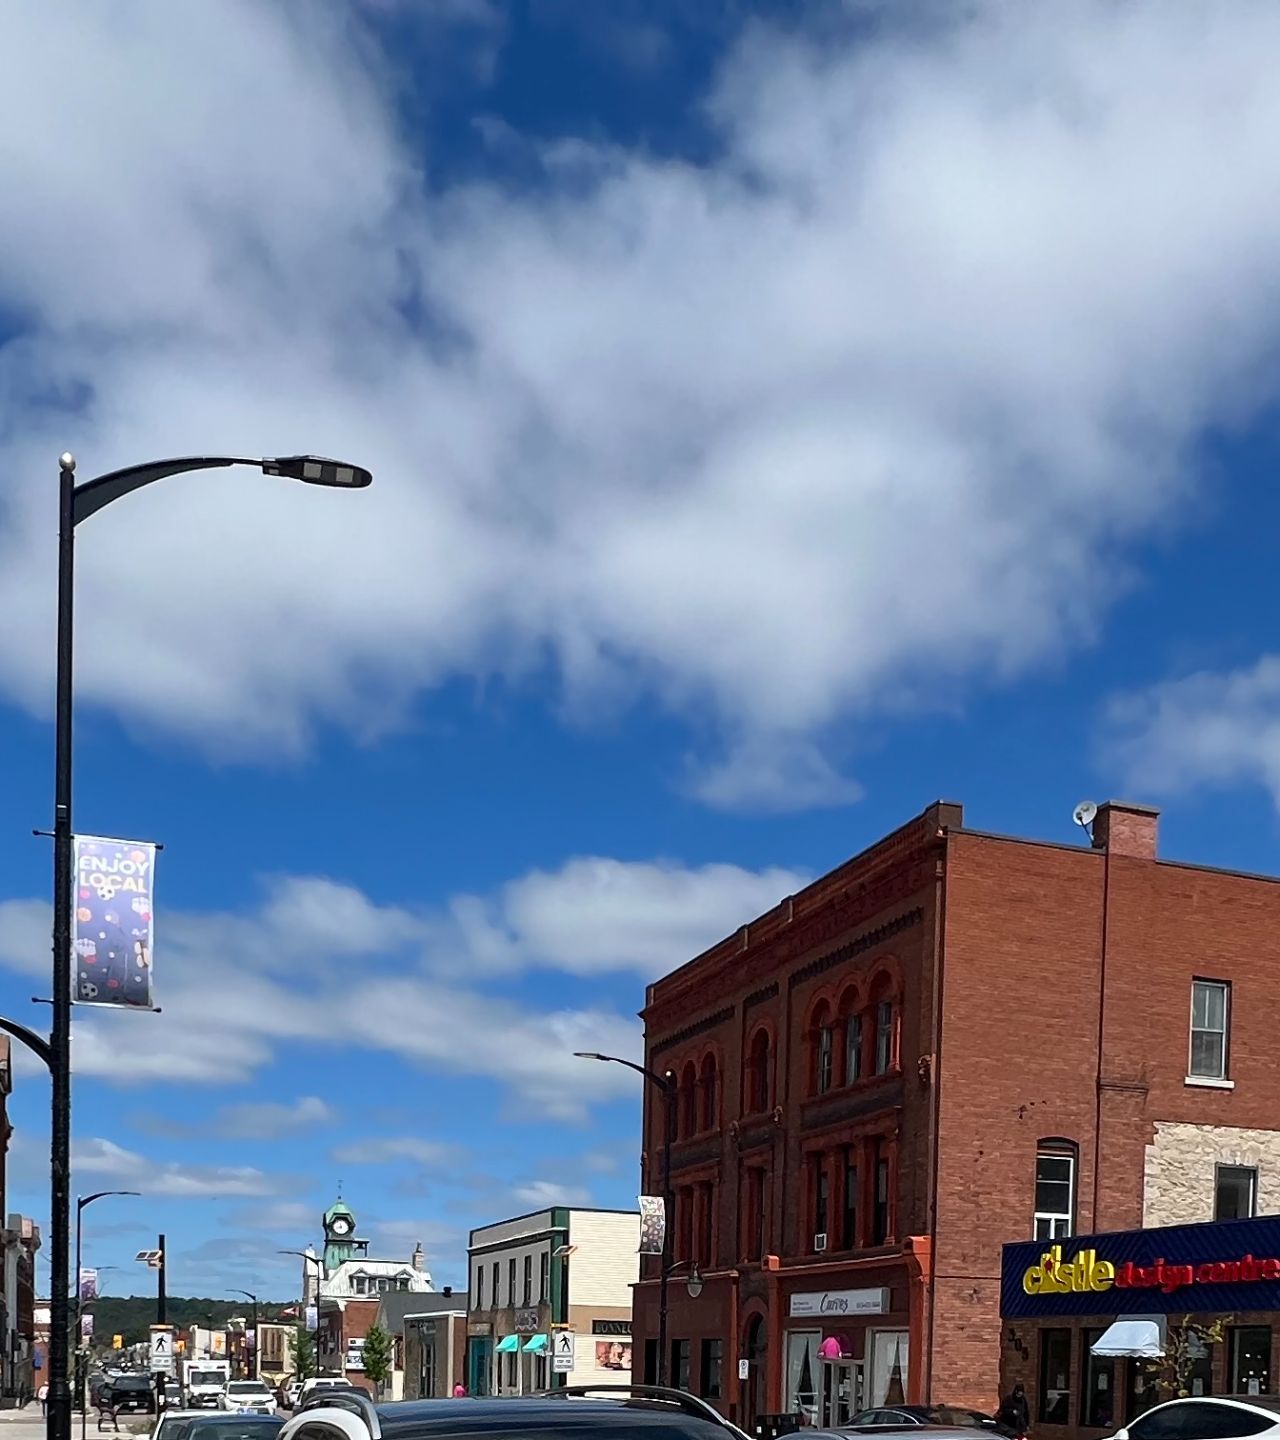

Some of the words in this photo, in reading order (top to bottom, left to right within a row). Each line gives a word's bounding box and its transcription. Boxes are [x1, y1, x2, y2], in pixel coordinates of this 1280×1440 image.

[79, 856, 150, 876] ENJOY
[79, 871, 148, 893] LOCAL
[1023, 1245, 1115, 1295] castle
[1115, 1257, 1193, 1293] design
